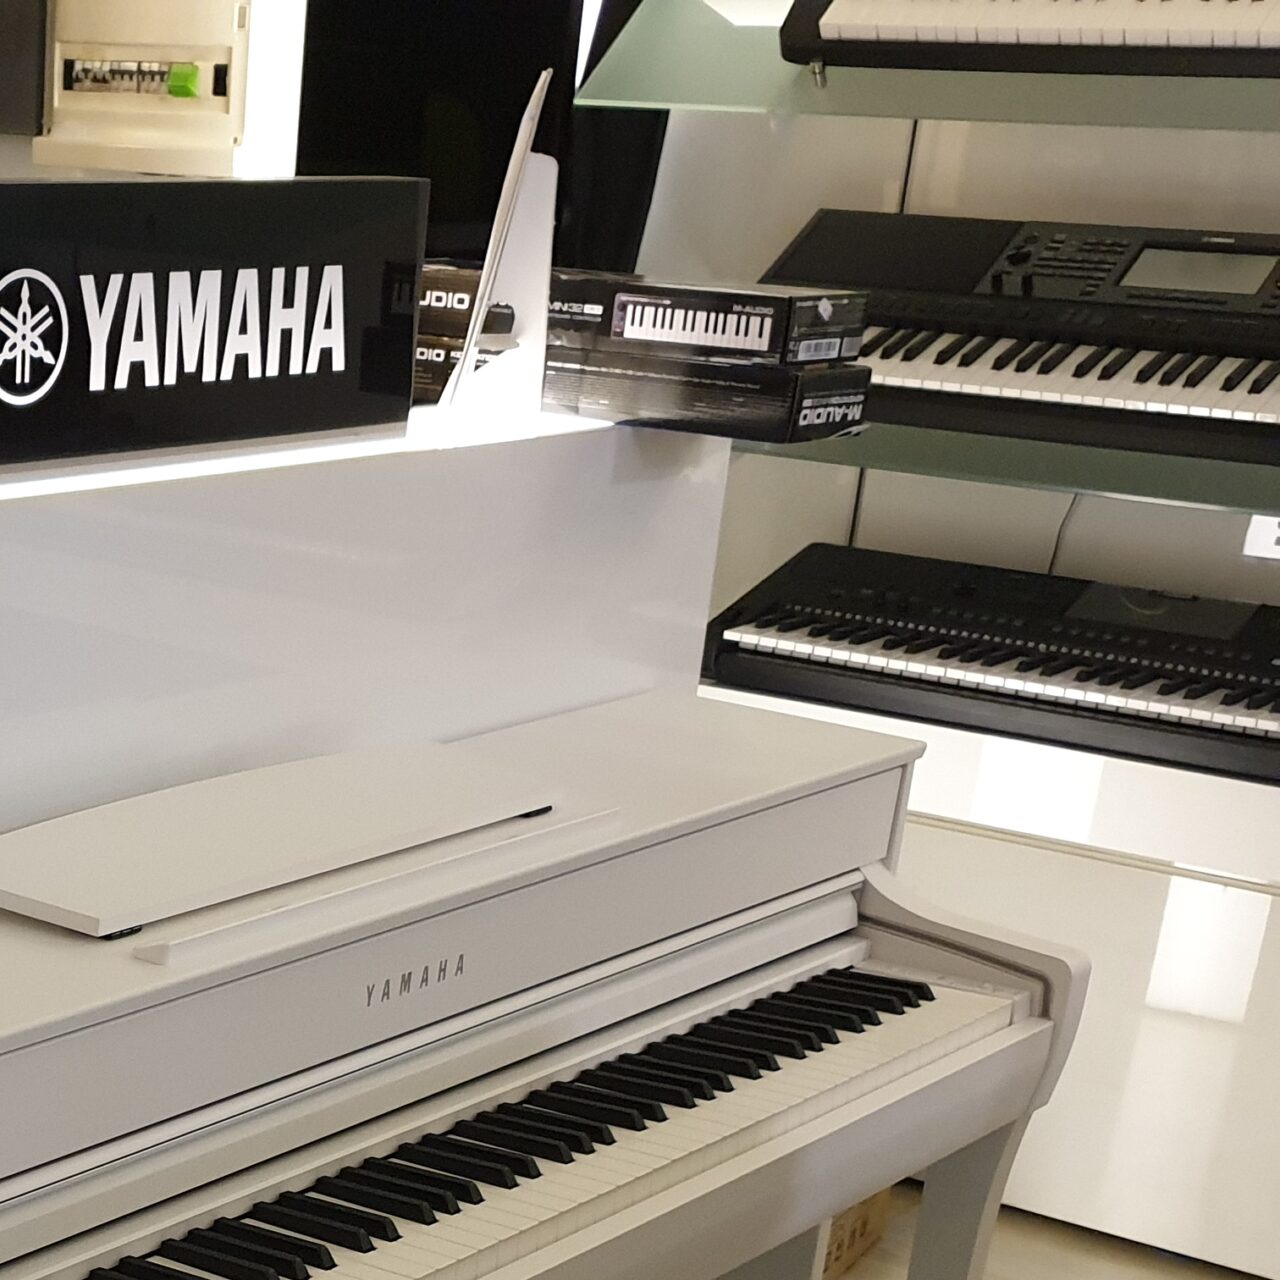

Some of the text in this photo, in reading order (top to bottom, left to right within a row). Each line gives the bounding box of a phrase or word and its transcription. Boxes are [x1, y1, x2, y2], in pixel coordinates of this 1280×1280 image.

[79, 264, 346, 392] YAMAHA
[799, 404, 863, 426] M-AUDIO
[366, 953, 465, 1008] YAMAHA
